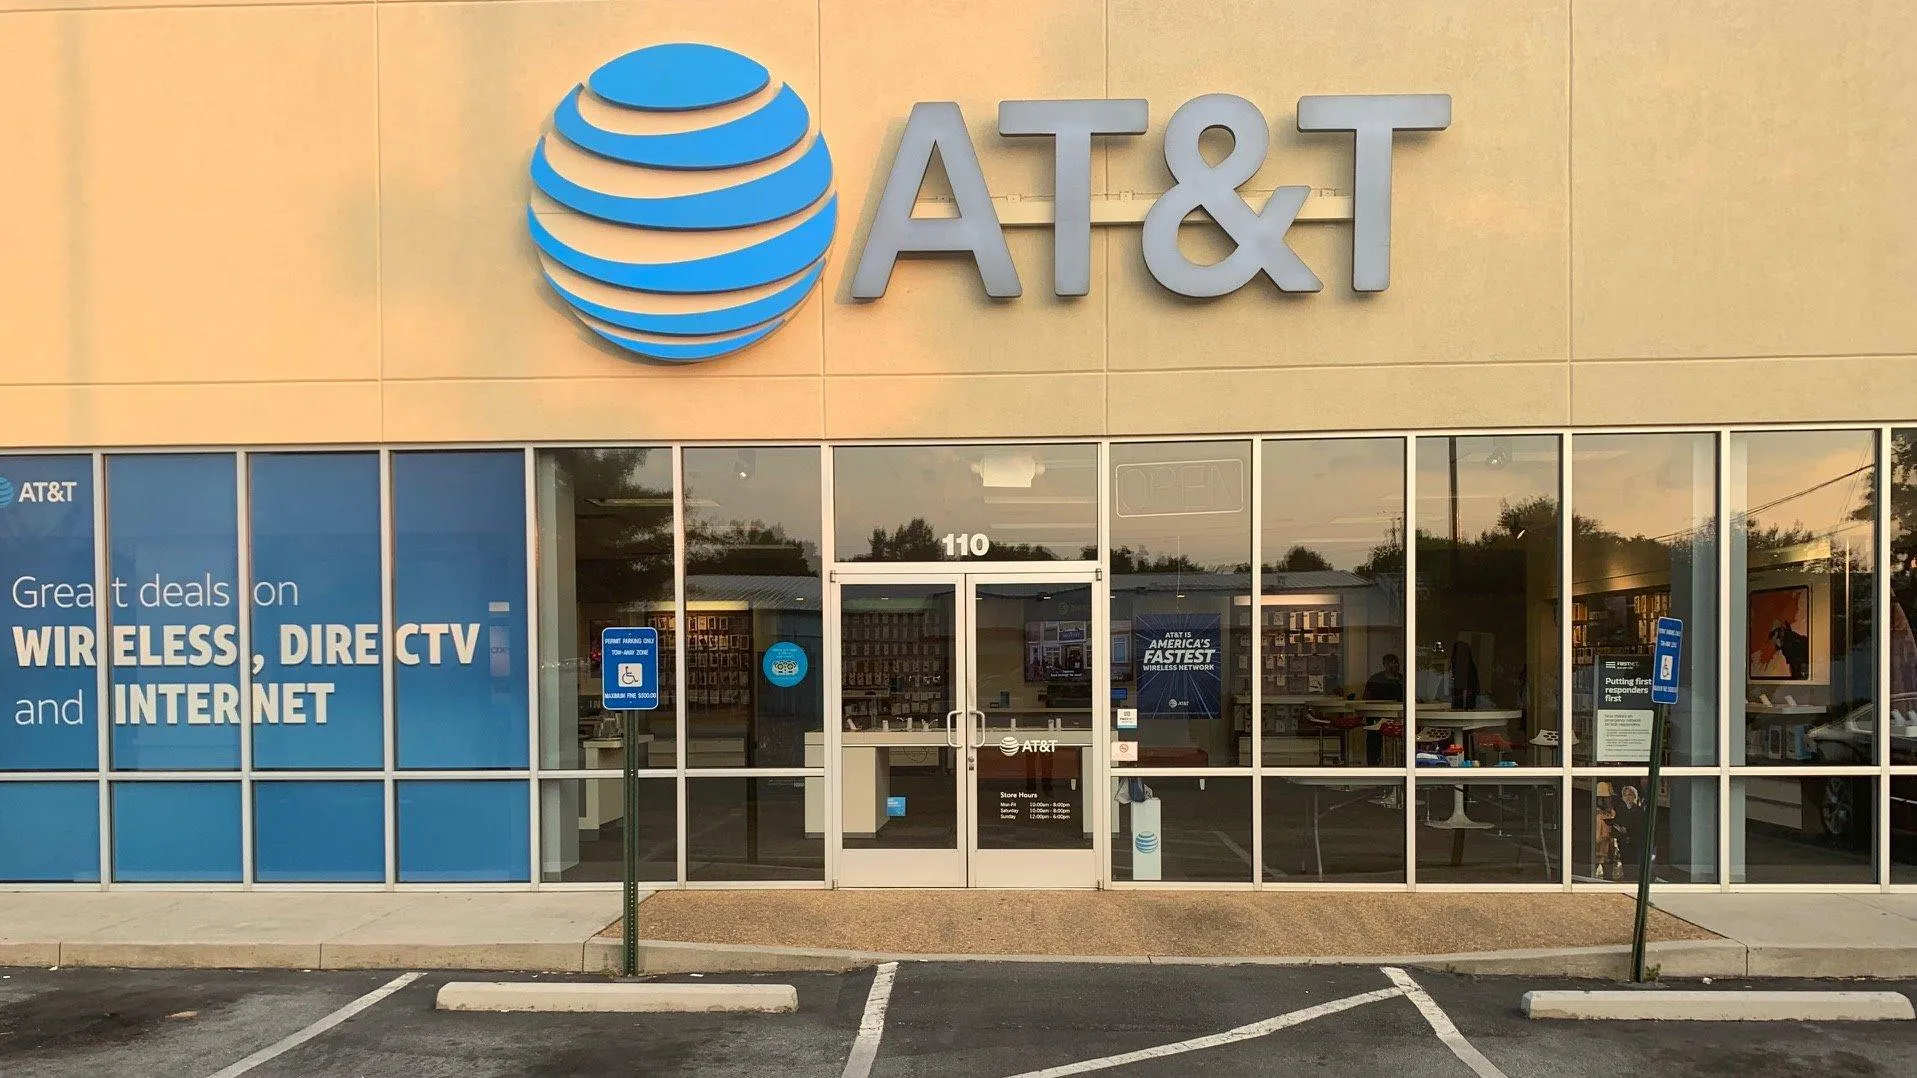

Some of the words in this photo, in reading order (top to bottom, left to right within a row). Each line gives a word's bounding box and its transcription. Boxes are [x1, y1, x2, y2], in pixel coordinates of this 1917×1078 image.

[851, 93, 1452, 299] AT&T
[18, 481, 78, 503] AT&T
[942, 533, 990, 556] 110
[12, 576, 128, 608] Great
[139, 573, 230, 607] deals
[253, 581, 299, 606] on
[12, 624, 265, 675] WIRELESS,
[280, 623, 481, 666] DIRECTV
[1148, 638, 1211, 648] AMERICA'S
[1143, 649, 1216, 664] FASTEST
[1605, 677, 1634, 686] Putting
[1635, 677, 1652, 685] first
[1605, 686, 1649, 694] responders
[15, 689, 83, 725] and
[114, 683, 335, 724] INTERNET
[1605, 694, 1622, 702] first
[1022, 740, 1058, 752] AT&T
[1000, 791, 1018, 799] Store
[1018, 791, 1038, 799] Hours
